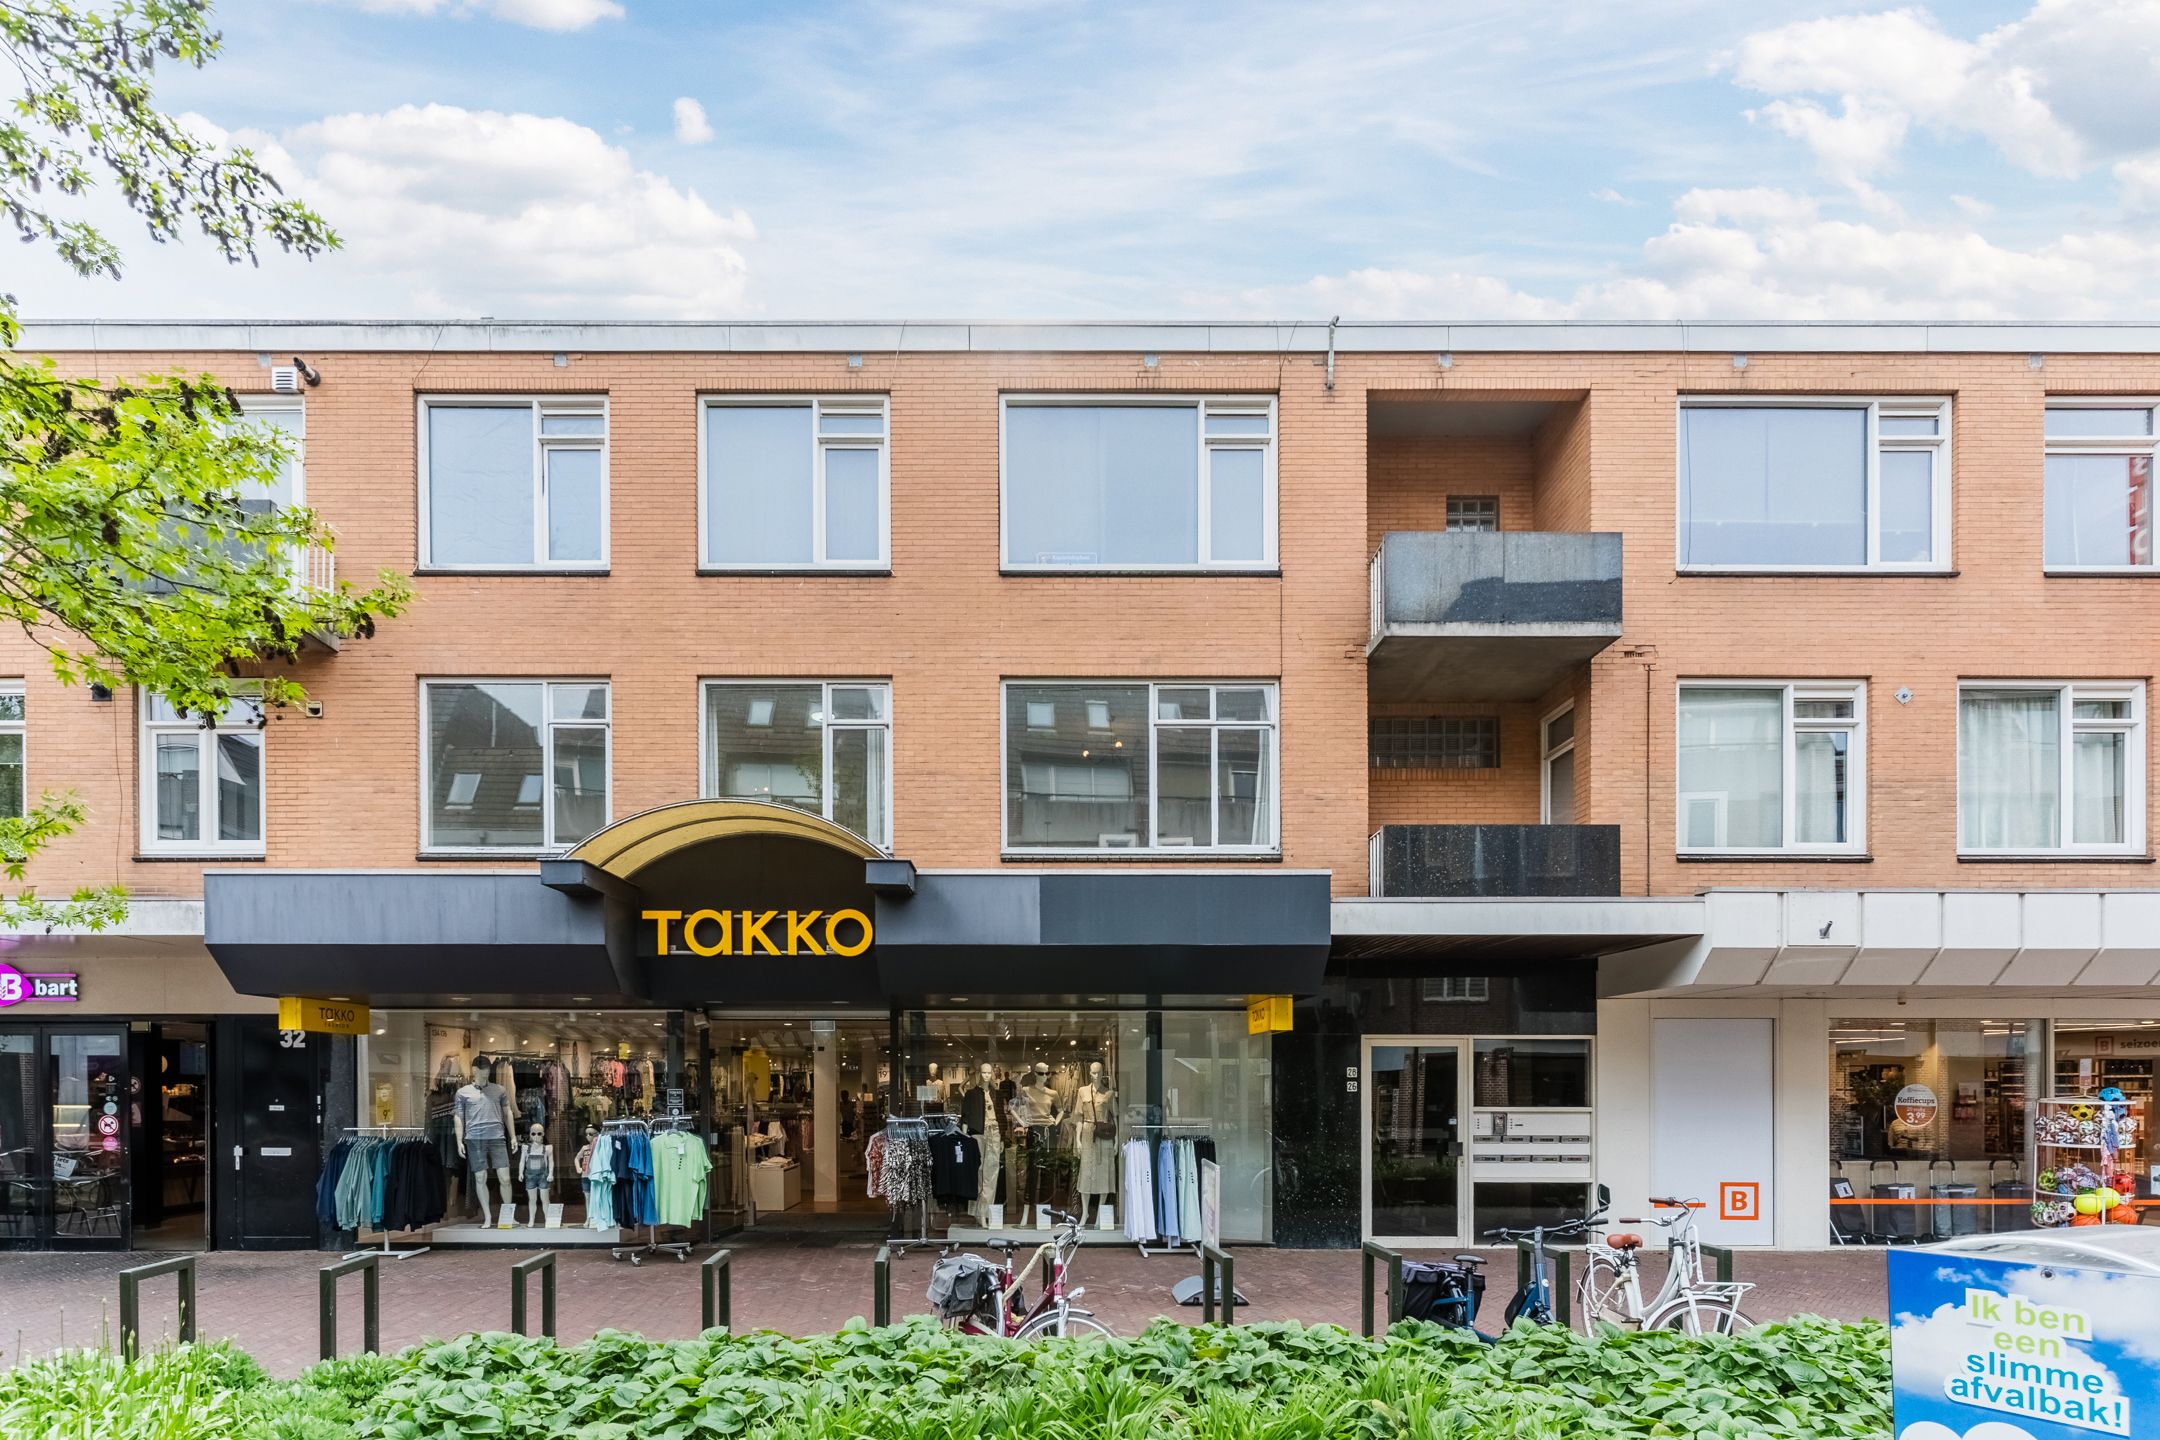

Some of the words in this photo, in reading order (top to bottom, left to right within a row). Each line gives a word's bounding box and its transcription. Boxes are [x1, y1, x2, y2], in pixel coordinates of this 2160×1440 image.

[34, 979, 78, 996] bart
[279, 1030, 306, 1049] 32
[2100, 1040, 2109, 1051] B
[1347, 1082, 1357, 1091] 26
[1897, 1096, 1936, 1106] Koffiecups
[1731, 1190, 1748, 1211] B
[1971, 1294, 2001, 1322] Ik
[2014, 1299, 2085, 1334] ben
[1993, 1330, 2060, 1359] een
[1966, 1351, 2104, 1395] slimme
[1950, 1375, 2122, 1429] afvalbak!
